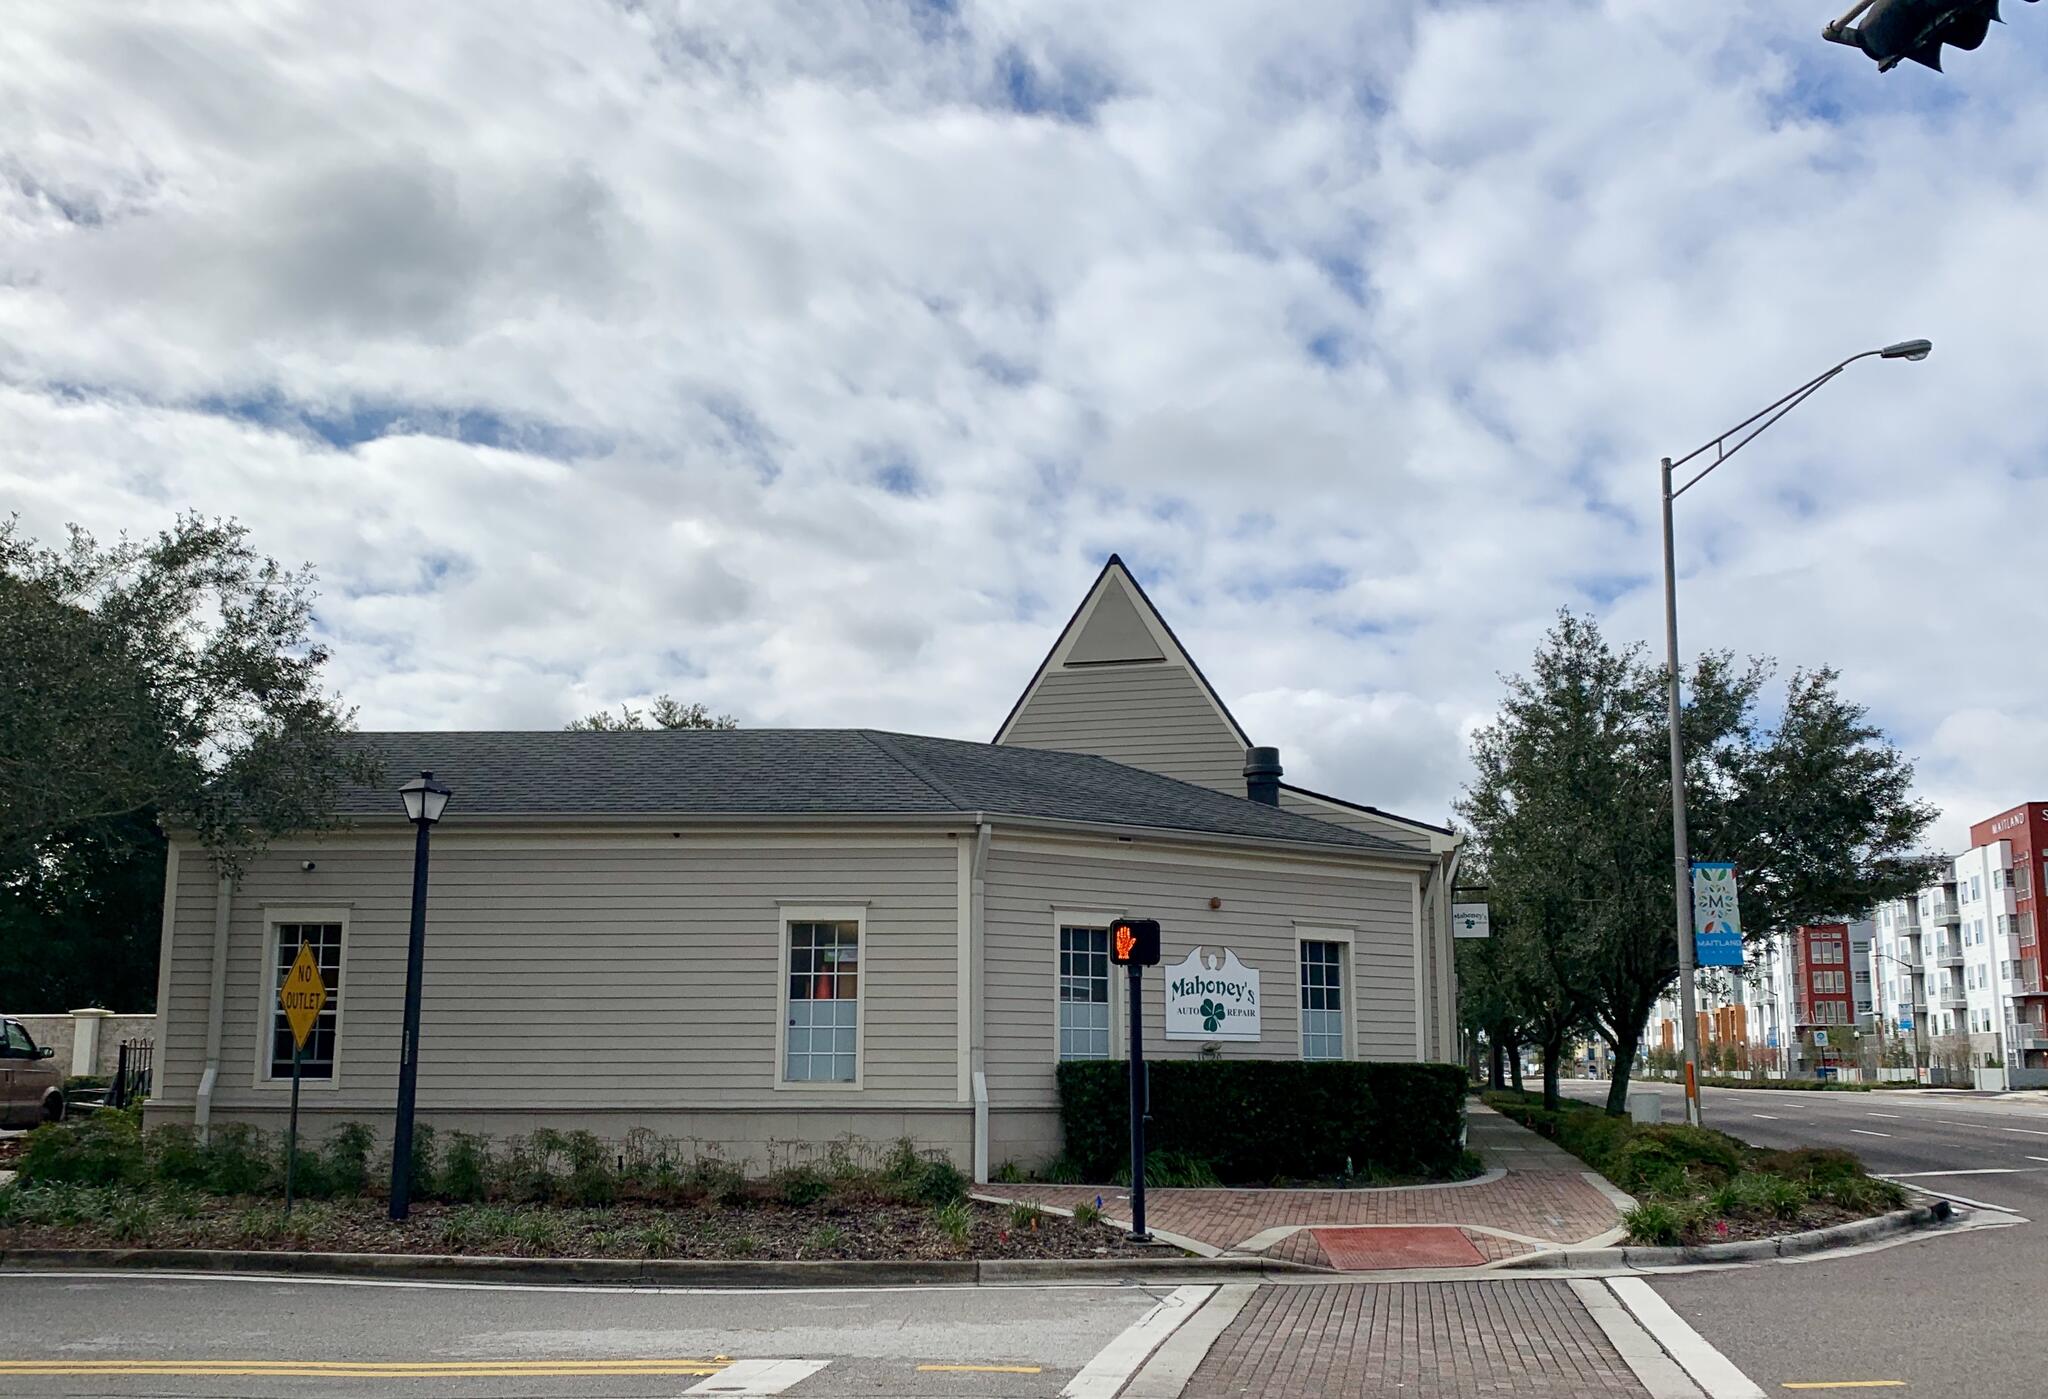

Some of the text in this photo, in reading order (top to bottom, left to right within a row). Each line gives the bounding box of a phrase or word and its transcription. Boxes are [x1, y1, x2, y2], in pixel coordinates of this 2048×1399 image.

[1992, 812, 2025, 834] MAITLAND
[1709, 895, 1724, 908] M
[298, 965, 312, 982] NO
[1171, 975, 1255, 1005] Mahoney's
[286, 992, 321, 1009] OUTLET
[1177, 1007, 1256, 1017] AUTO REPAIR
